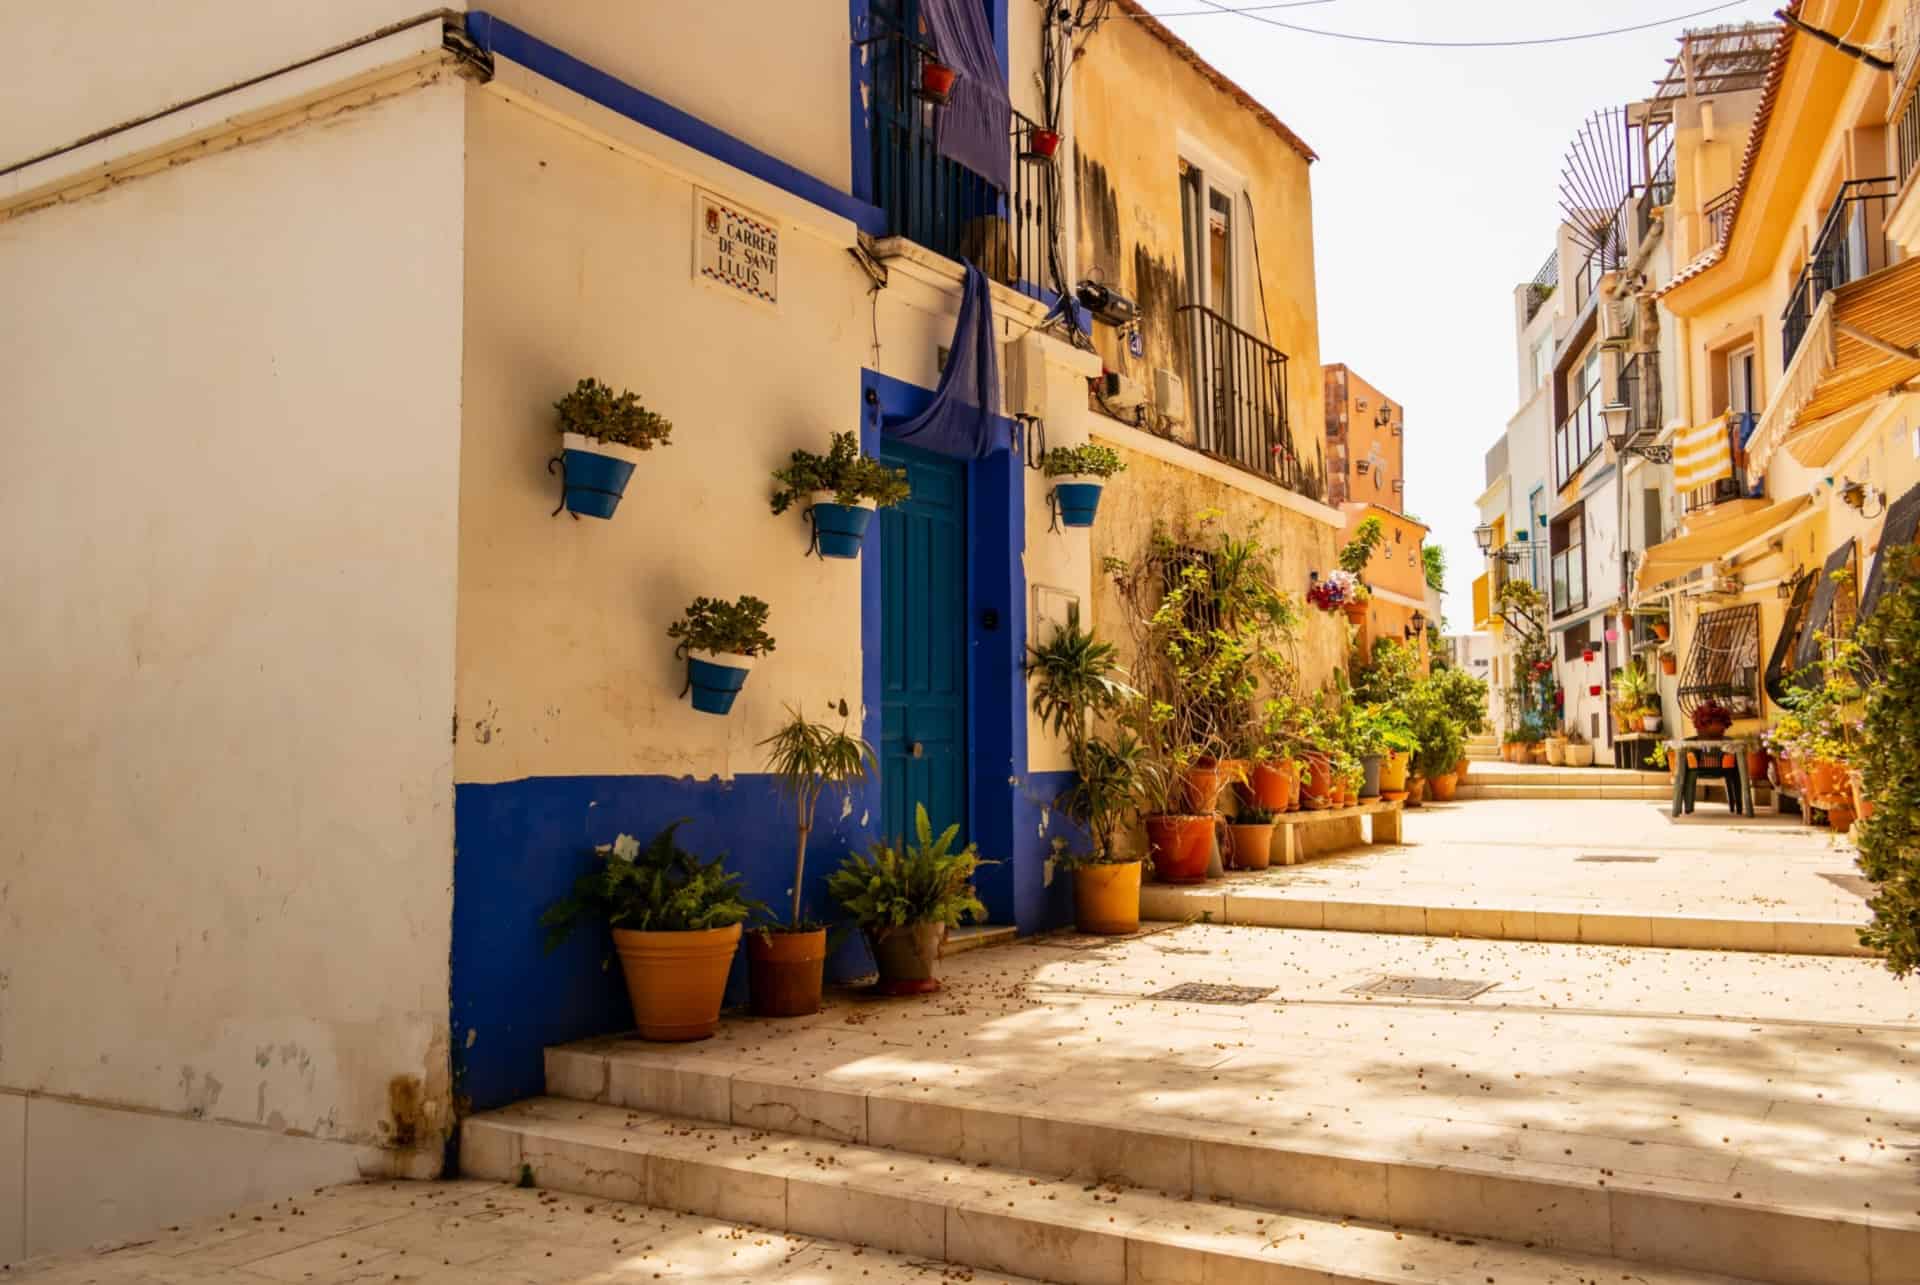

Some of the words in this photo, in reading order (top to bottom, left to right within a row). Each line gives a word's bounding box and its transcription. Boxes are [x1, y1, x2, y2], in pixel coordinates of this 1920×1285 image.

[719, 236, 735, 257] DE
[744, 248, 775, 275] SANT
[727, 223, 776, 257] CARRER
